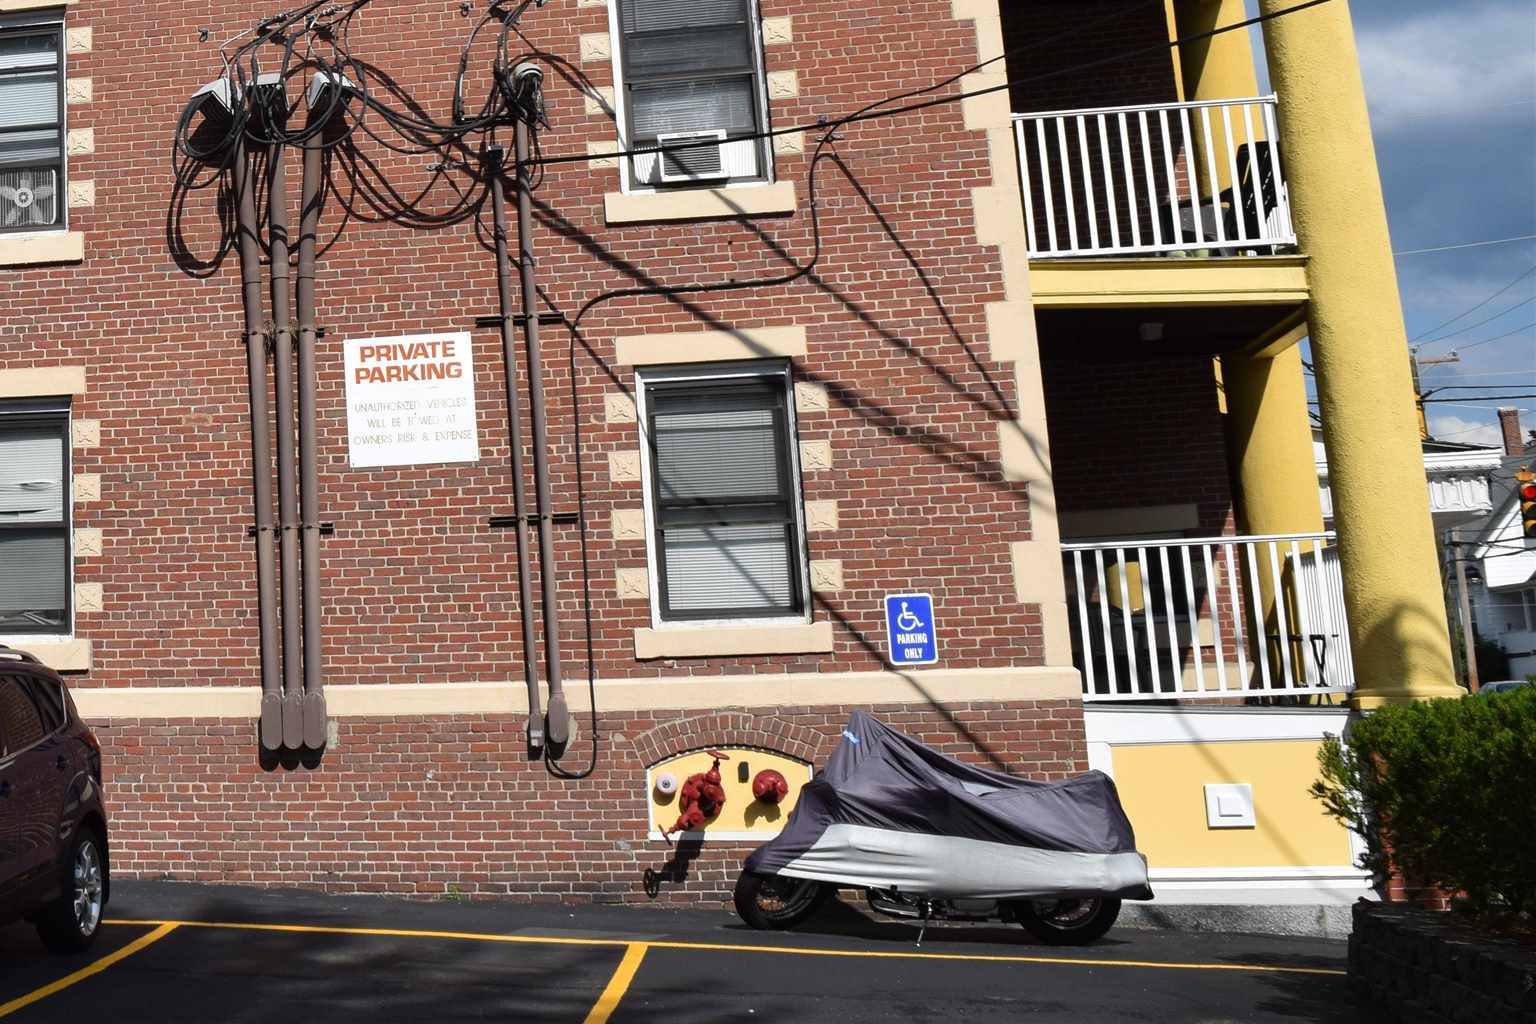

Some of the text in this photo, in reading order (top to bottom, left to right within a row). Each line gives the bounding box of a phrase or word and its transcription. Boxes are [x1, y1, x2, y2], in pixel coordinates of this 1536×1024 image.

[360, 340, 455, 363] PRIVATE
[355, 362, 462, 384] PARKING
[896, 633, 928, 644] PARKING
[905, 648, 923, 659] ONLY
